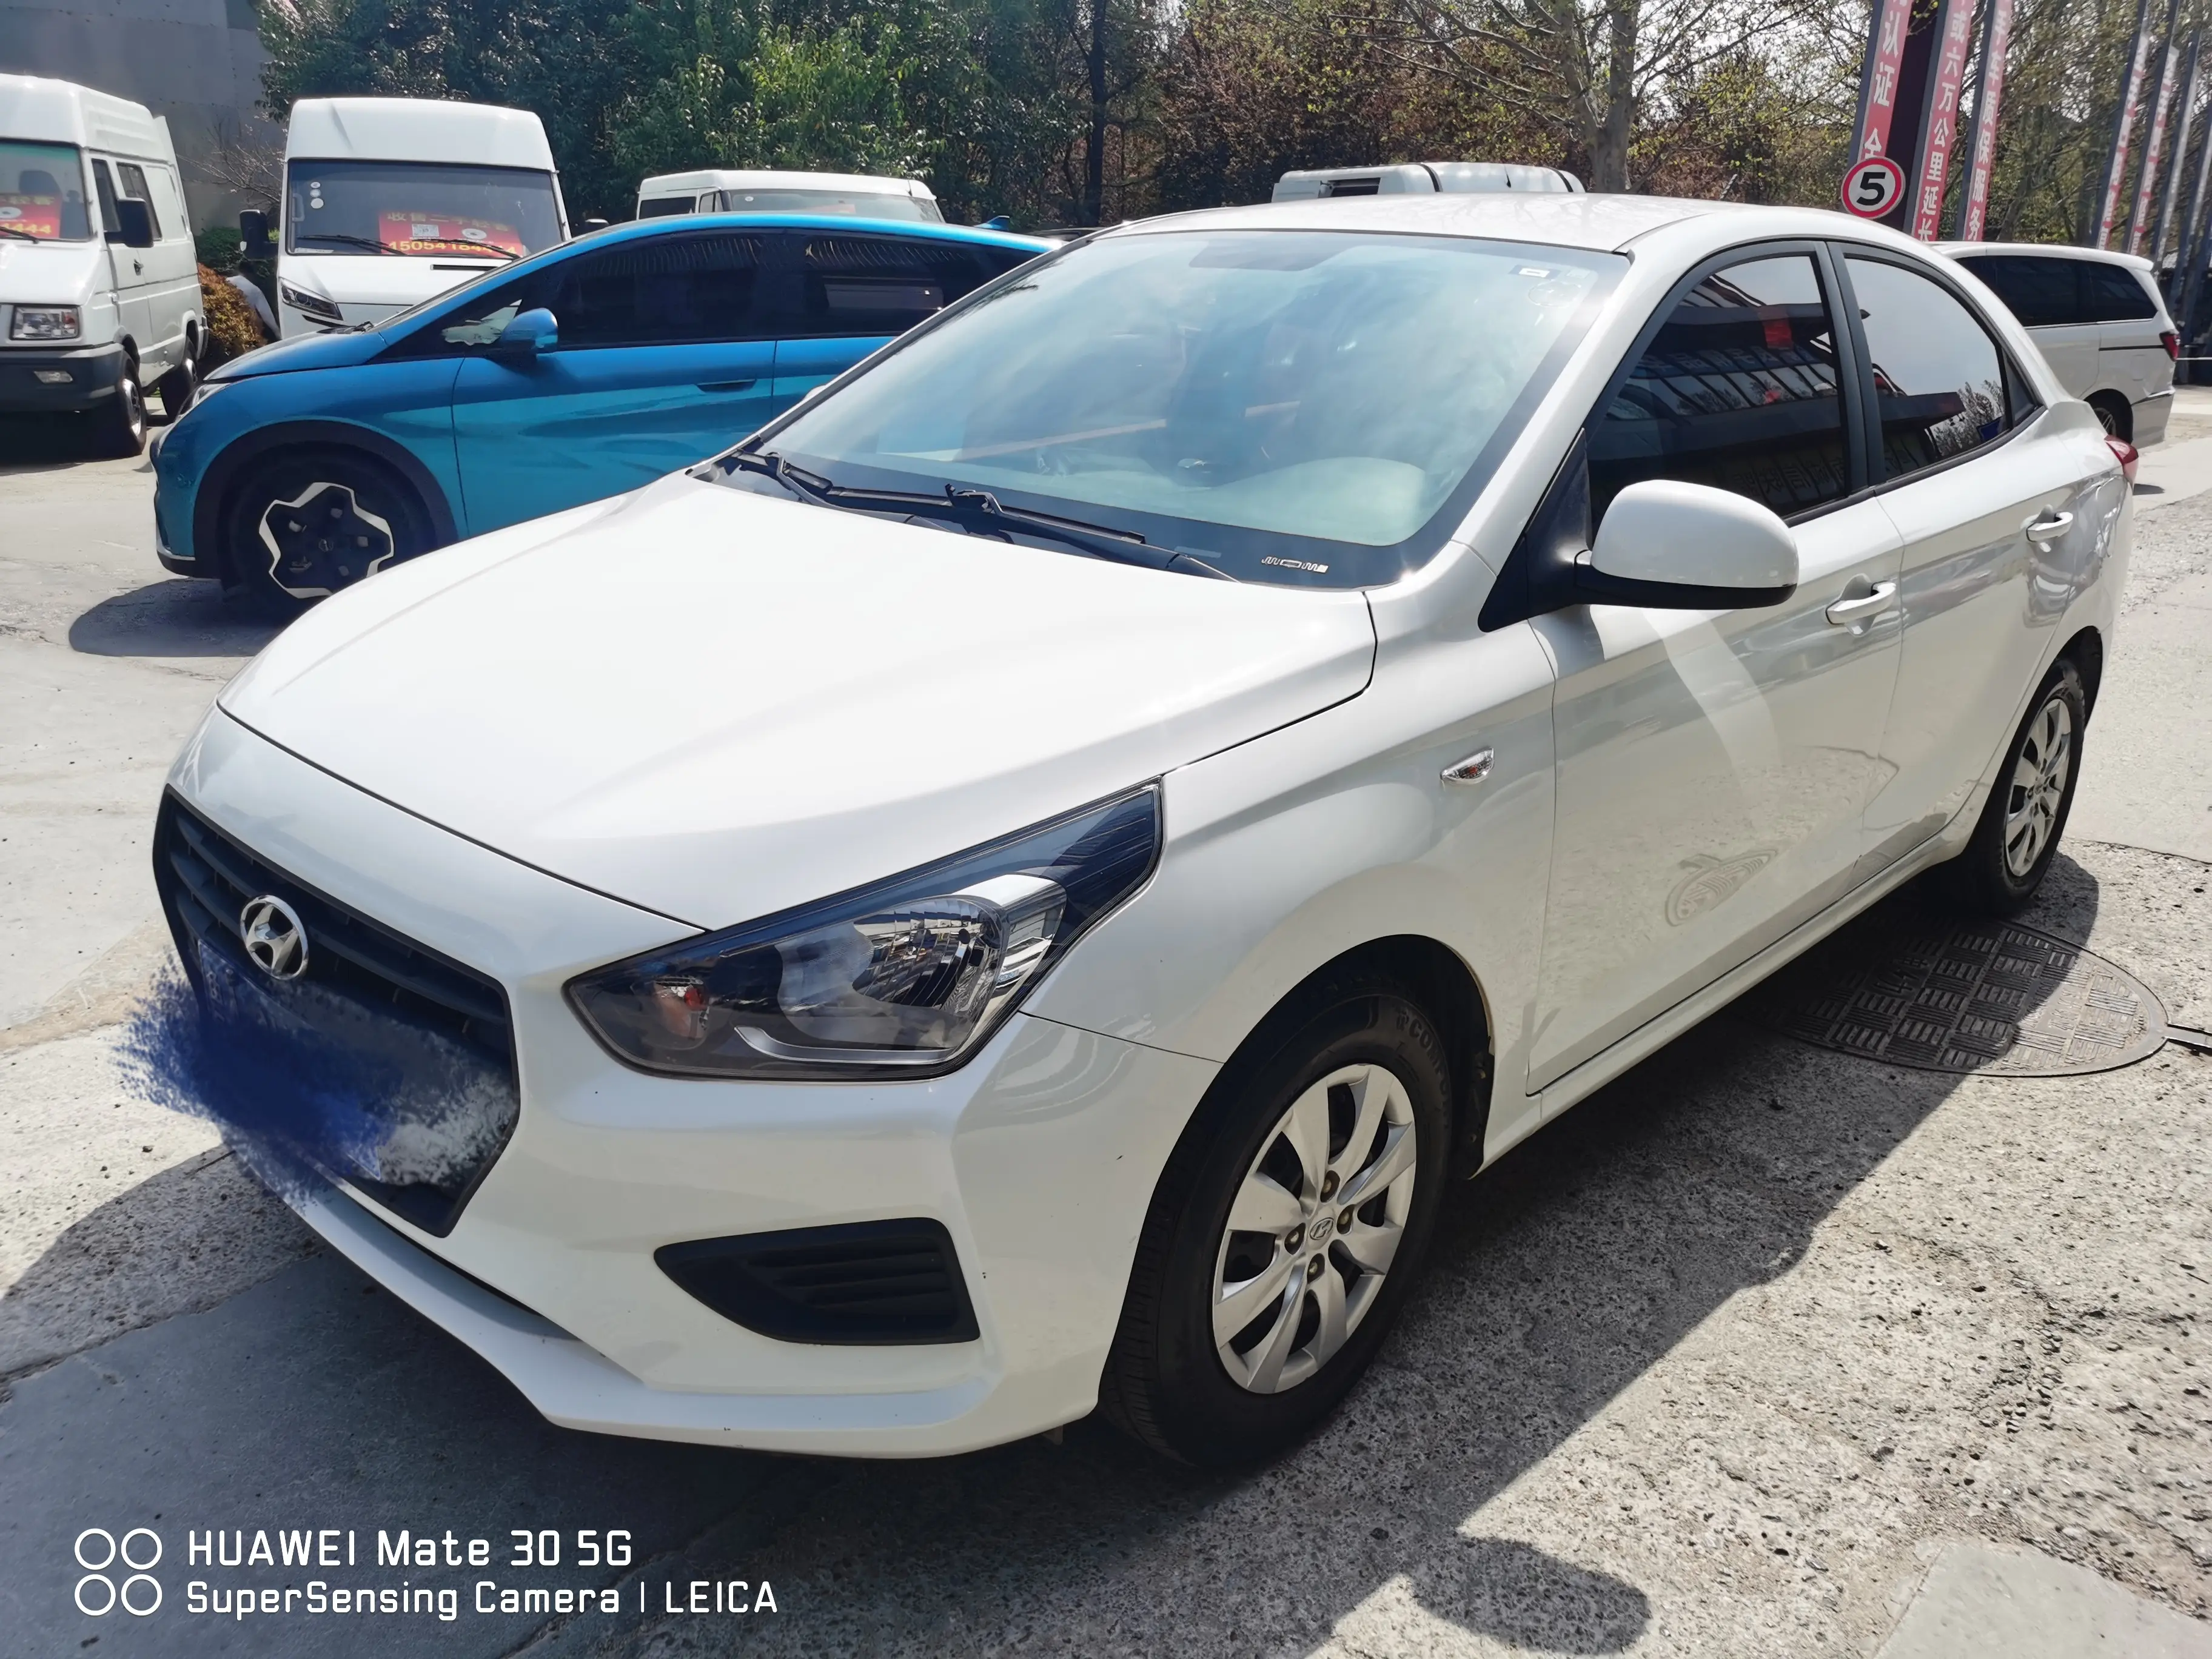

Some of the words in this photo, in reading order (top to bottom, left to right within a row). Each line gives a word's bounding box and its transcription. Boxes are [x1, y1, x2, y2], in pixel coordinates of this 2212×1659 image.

[1873, 0, 1908, 107] 认证
[1918, 0, 1968, 242] 或六万公里延长
[1857, 172, 1886, 206] 5
